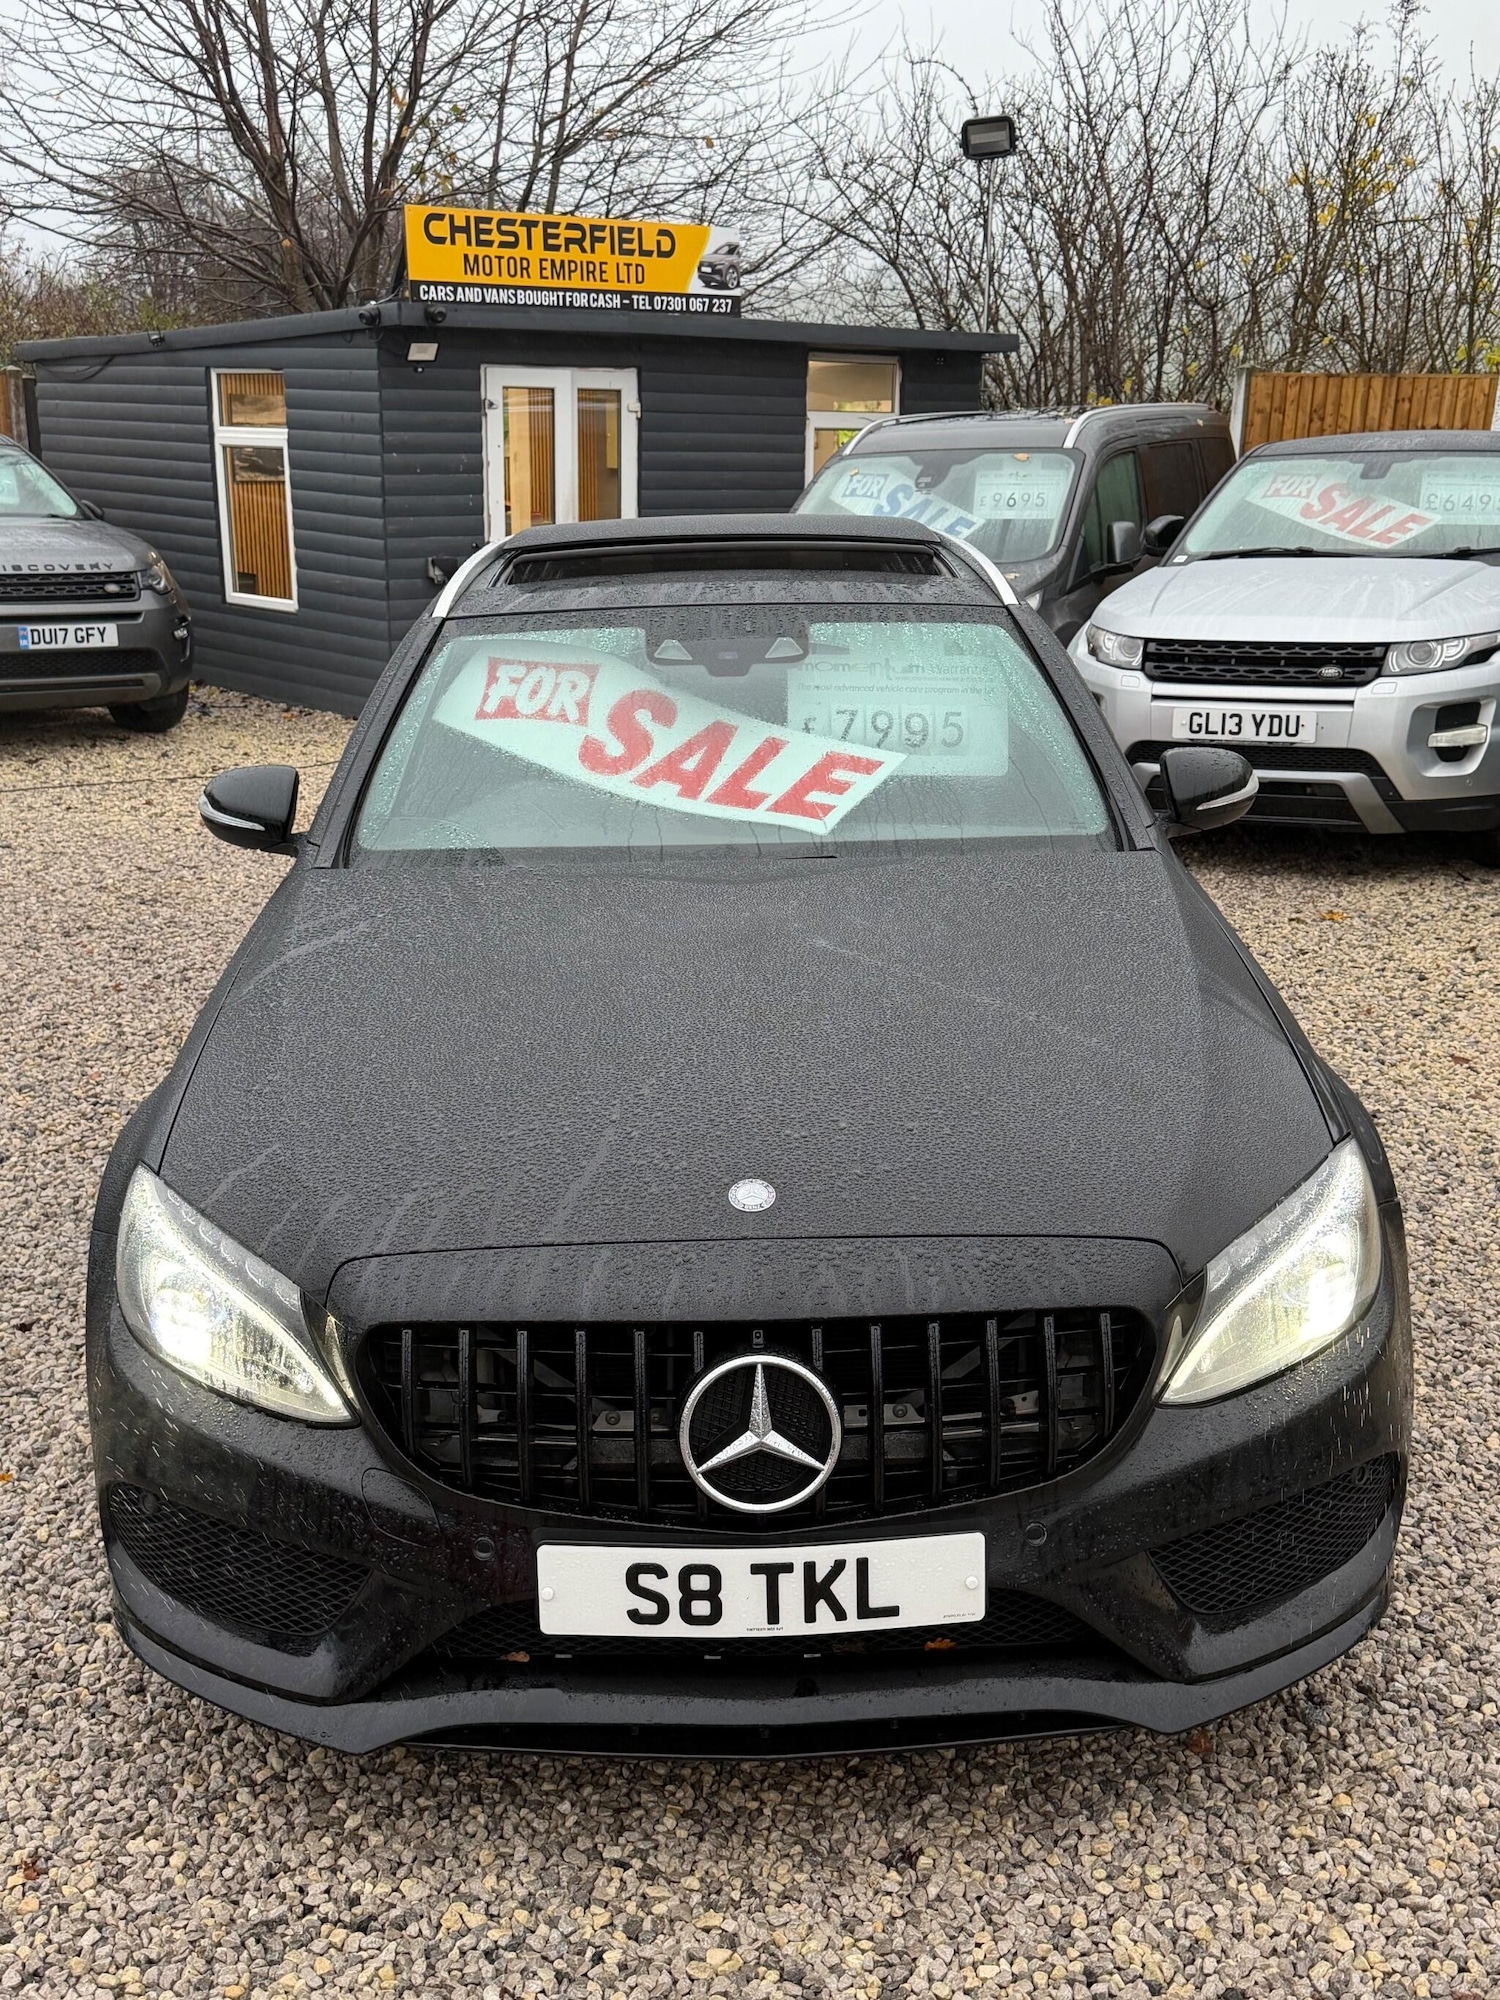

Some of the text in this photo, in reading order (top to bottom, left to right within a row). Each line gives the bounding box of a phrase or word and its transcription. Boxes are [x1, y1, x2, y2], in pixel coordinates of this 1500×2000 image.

[423, 213, 676, 258] CHESTERFIELD
[463, 253, 645, 285] MOTOR EMPIRE LTD
[420, 285, 455, 301] CARS
[456, 286, 482, 303] AND
[483, 288, 516, 304] VANS
[517, 289, 565, 307] BOUGHT
[565, 292, 590, 307] FOR
[590, 293, 621, 309] CASH
[632, 295, 652, 310] TEL
[654, 296, 686, 311] 07301
[689, 298, 709, 312] 067
[712, 299, 732, 313] 237
[846, 474, 885, 498] FOR
[1266, 475, 1433, 545] FOR SALE
[0, 562, 113, 571] ISCOVERY
[30, 626, 107, 646] DU17 GFY
[834, 683, 874, 692] advanced
[876, 685, 904, 693] vehicle
[925, 686, 960, 695] program
[969, 686, 982, 694] the
[1189, 712, 1300, 737] GL13 YDU
[478, 661, 885, 820] FOR SALE
[626, 1557, 900, 1626] S8 TKL
